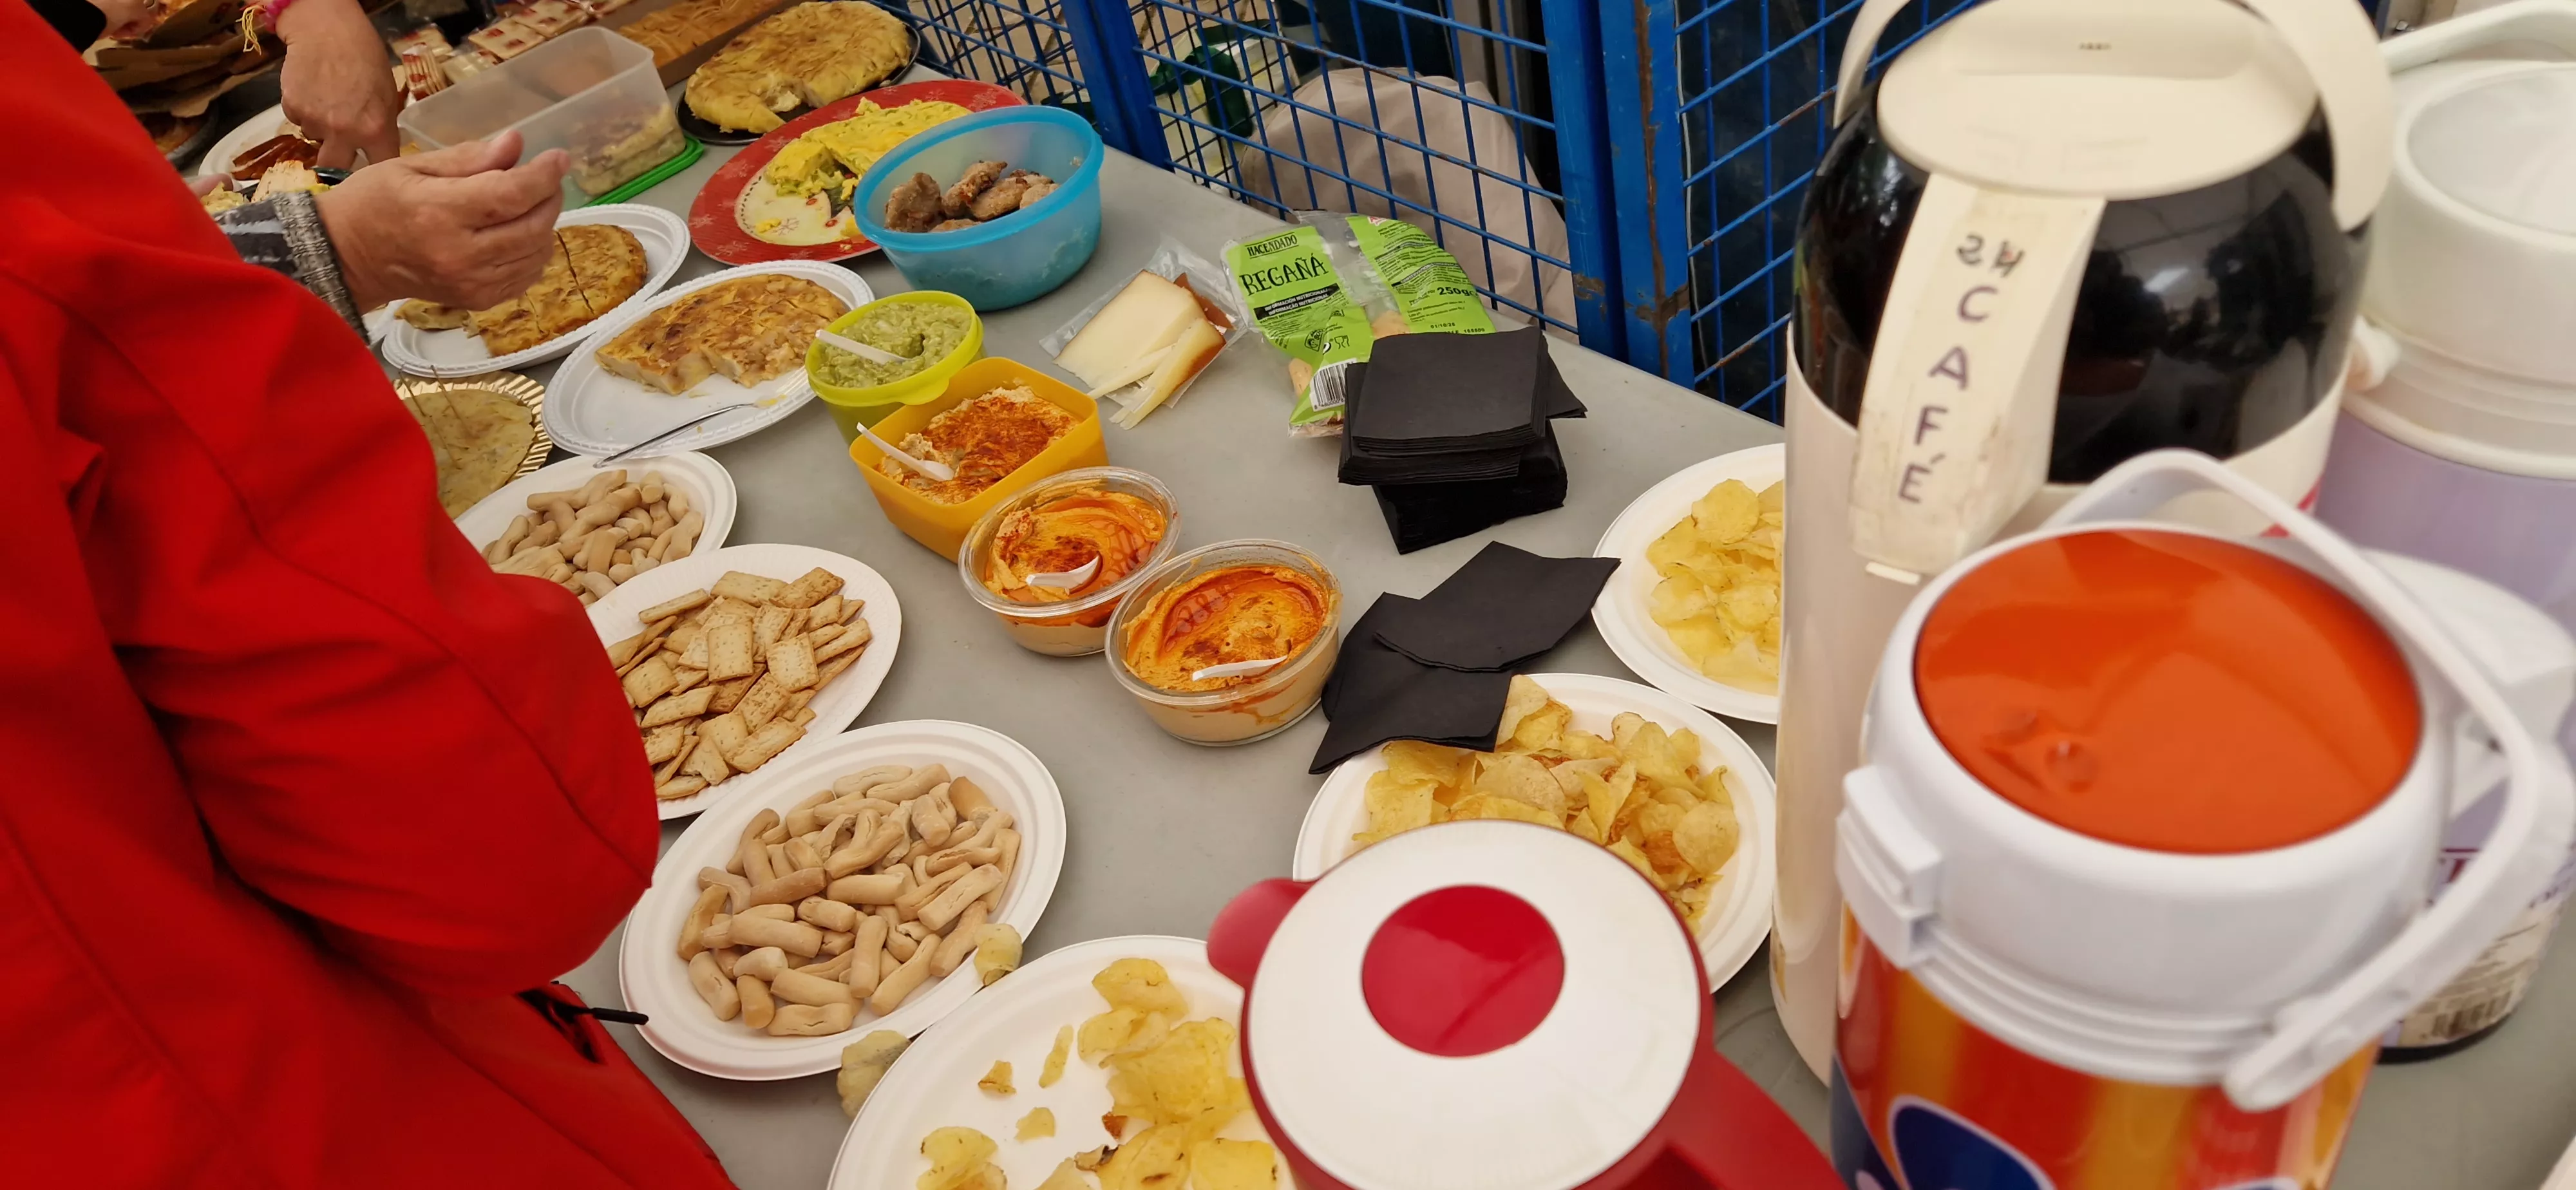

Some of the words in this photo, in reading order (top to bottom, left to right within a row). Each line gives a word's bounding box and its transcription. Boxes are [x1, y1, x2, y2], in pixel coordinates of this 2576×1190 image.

[1247, 234, 1298, 257] HACENDADO
[1239, 252, 1329, 296] REGAÑÁ
[1264, 297, 1296, 312] INFORMACIÓN
[1268, 303, 1299, 316] INFORMAÇÃO
[1897, 286, 1998, 505] CAFÉ
